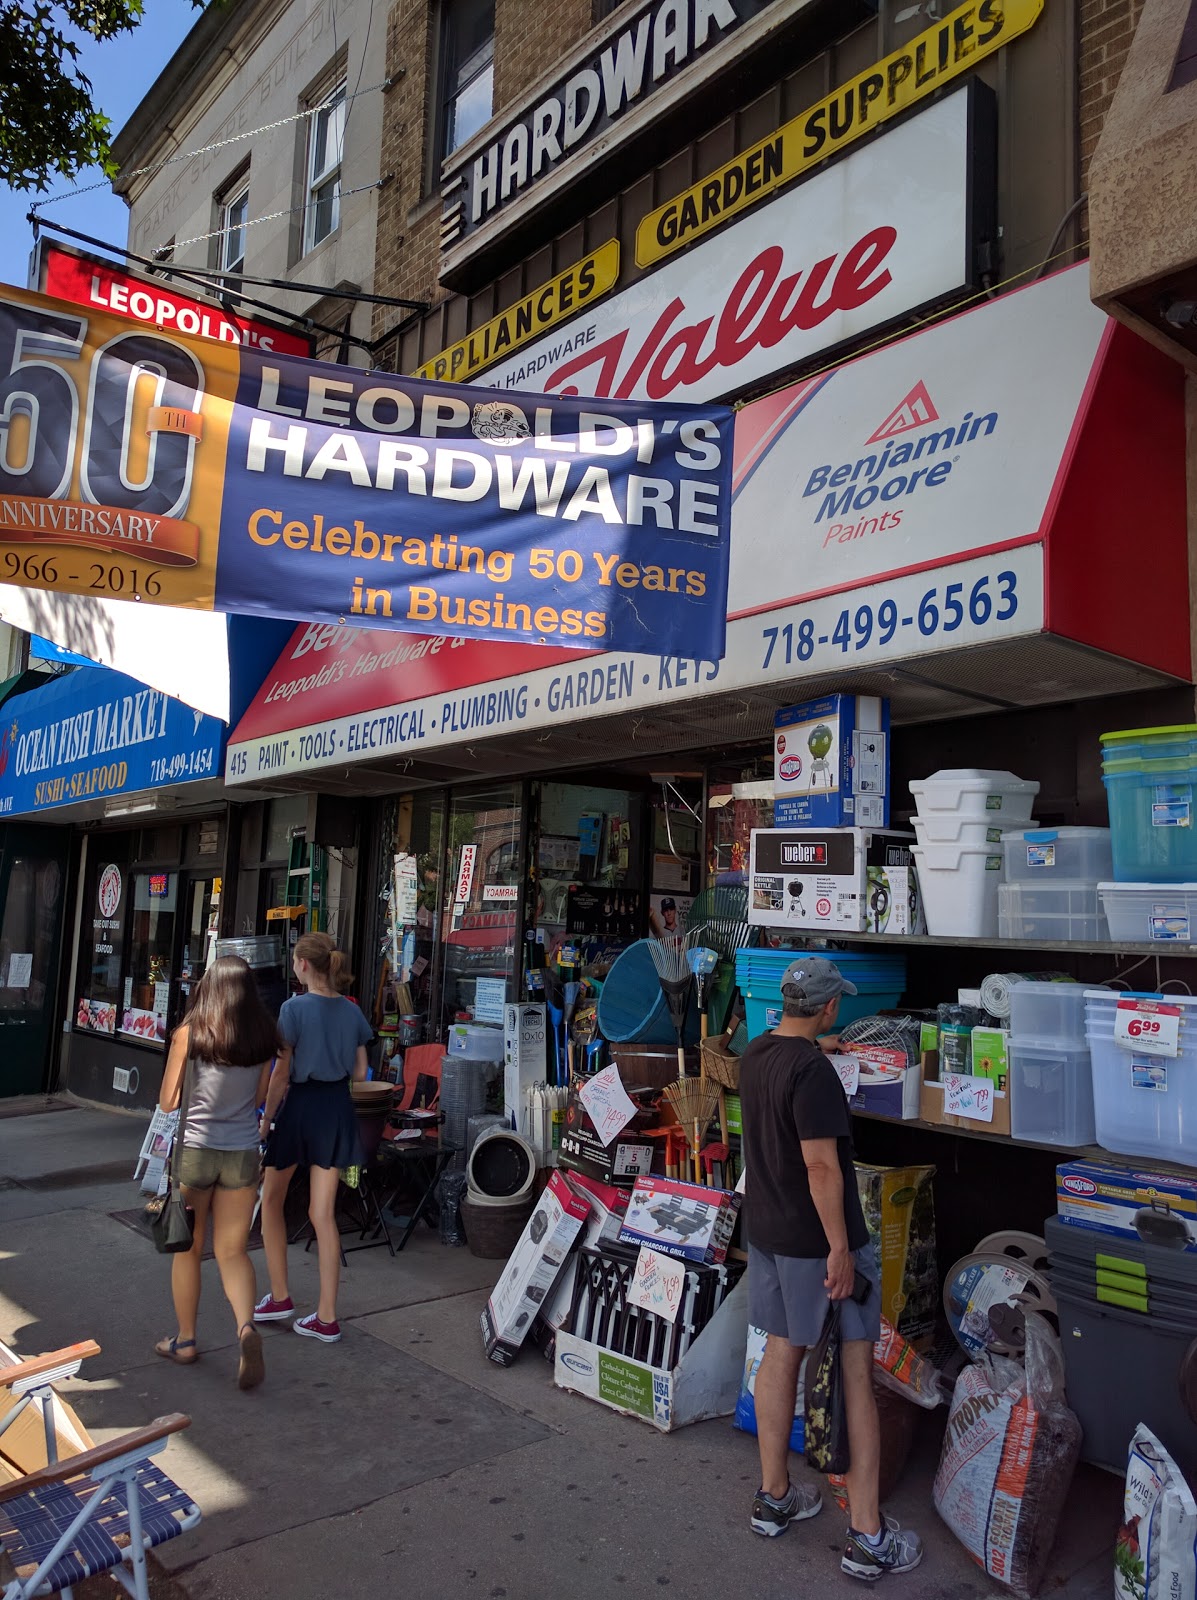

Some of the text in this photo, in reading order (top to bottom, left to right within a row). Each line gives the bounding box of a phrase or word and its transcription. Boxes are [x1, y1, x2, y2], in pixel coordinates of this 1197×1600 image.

[472, 0, 739, 222] HARDWAR
[656, 0, 1004, 247] GARDEN SUPPLIES
[543, 226, 898, 403] Value
[506, 324, 597, 389] HARDWARE
[0, 300, 206, 521] 50
[164, 411, 188, 430] TH
[257, 366, 722, 471] LEOPLDI'S
[246, 417, 721, 537] HARDWARE
[802, 411, 999, 499] Benjamin
[814, 461, 953, 524] Moore
[0, 501, 162, 544] NNIVERSARY
[822, 509, 905, 549] Paints
[5, 552, 59, 583] 966
[89, 564, 162, 597] 2016
[247, 509, 708, 597] Celebrating 50 Years
[350, 577, 607, 639] in Business
[762, 570, 1019, 669] 718-499-6563
[263, 659, 348, 703] Leopoldi's
[348, 635, 446, 678] Hardware
[15, 688, 169, 777] OCEAN FISH MARKET
[230, 655, 721, 776] 415 PAINT TOOLS ELECTRICAL PLUMBING GARDEN KEYS
[34, 777, 66, 805] SUSHI
[69, 761, 128, 798] SEAFOOD
[150, 747, 213, 782] 718-499-1454
[784, 843, 815, 862] weber
[888, 845, 912, 866] weber
[677, 910, 690, 919] YO
[522, 1031, 544, 1041] 10x10
[631, 1153, 637, 1163] 5
[1065, 1179, 1095, 1192] KINGSFORD
[620, 1234, 641, 1245] HIBACHI
[641, 1238, 669, 1253] CHARCOAL
[669, 1247, 686, 1257] GRILL
[566, 1358, 592, 1372] suncast
[601, 1360, 640, 1382] Cathedral Fence
[601, 1385, 615, 1395] Cerca
[654, 1380, 669, 1398] USA
[991, 1548, 1006, 1577] 302
